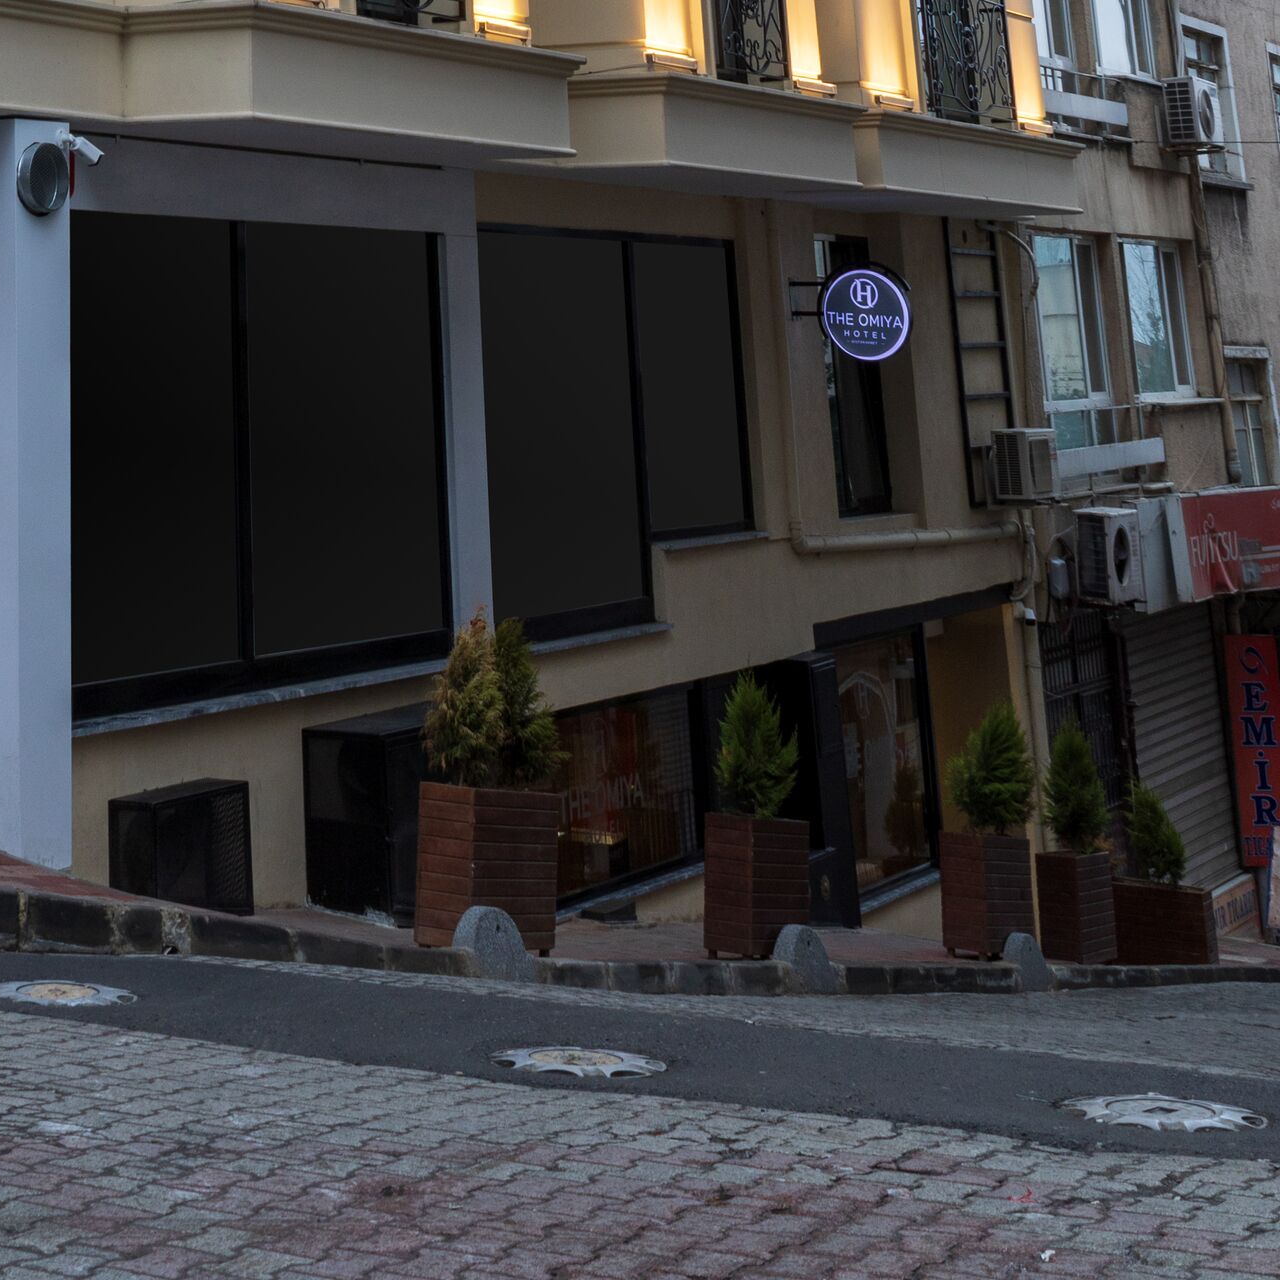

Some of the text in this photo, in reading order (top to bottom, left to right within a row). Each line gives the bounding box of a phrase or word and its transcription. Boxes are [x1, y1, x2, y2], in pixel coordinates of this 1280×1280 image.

[827, 311, 903, 328] THE OMIYA
[844, 330, 886, 339] HOTEL
[1189, 520, 1239, 574] FUJITSU
[1240, 682, 1280, 826] EMİR
[559, 772, 644, 824] THE OMIYA
